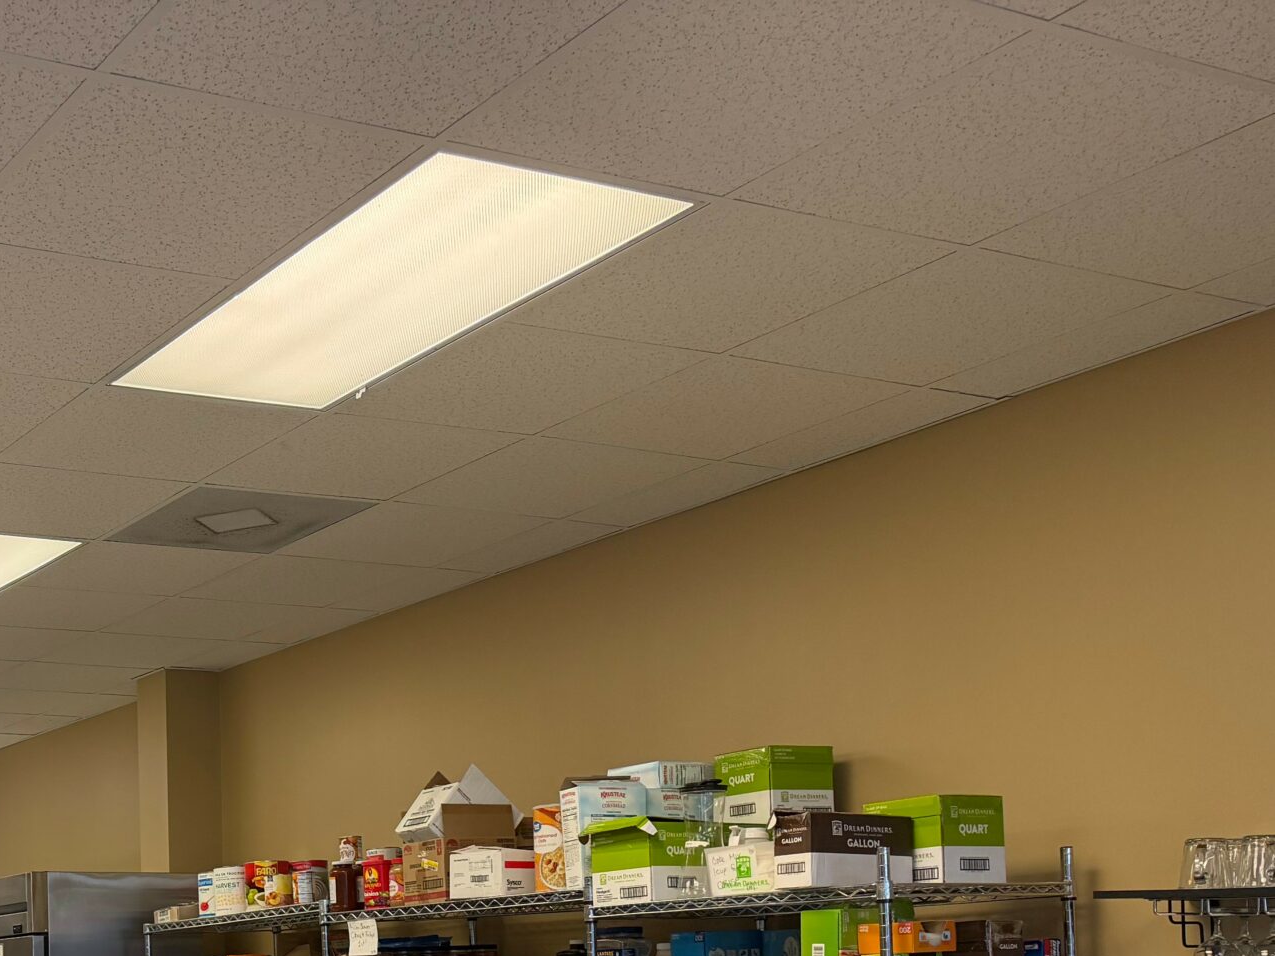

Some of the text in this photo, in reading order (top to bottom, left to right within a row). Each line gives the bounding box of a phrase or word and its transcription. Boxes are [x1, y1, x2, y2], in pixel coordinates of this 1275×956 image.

[728, 773, 755, 786] QUART
[844, 824, 865, 832] DREAM
[958, 823, 989, 836] QUART
[781, 836, 802, 844] GALLON
[847, 838, 881, 849] GALLON
[899, 926, 912, 934] 200
